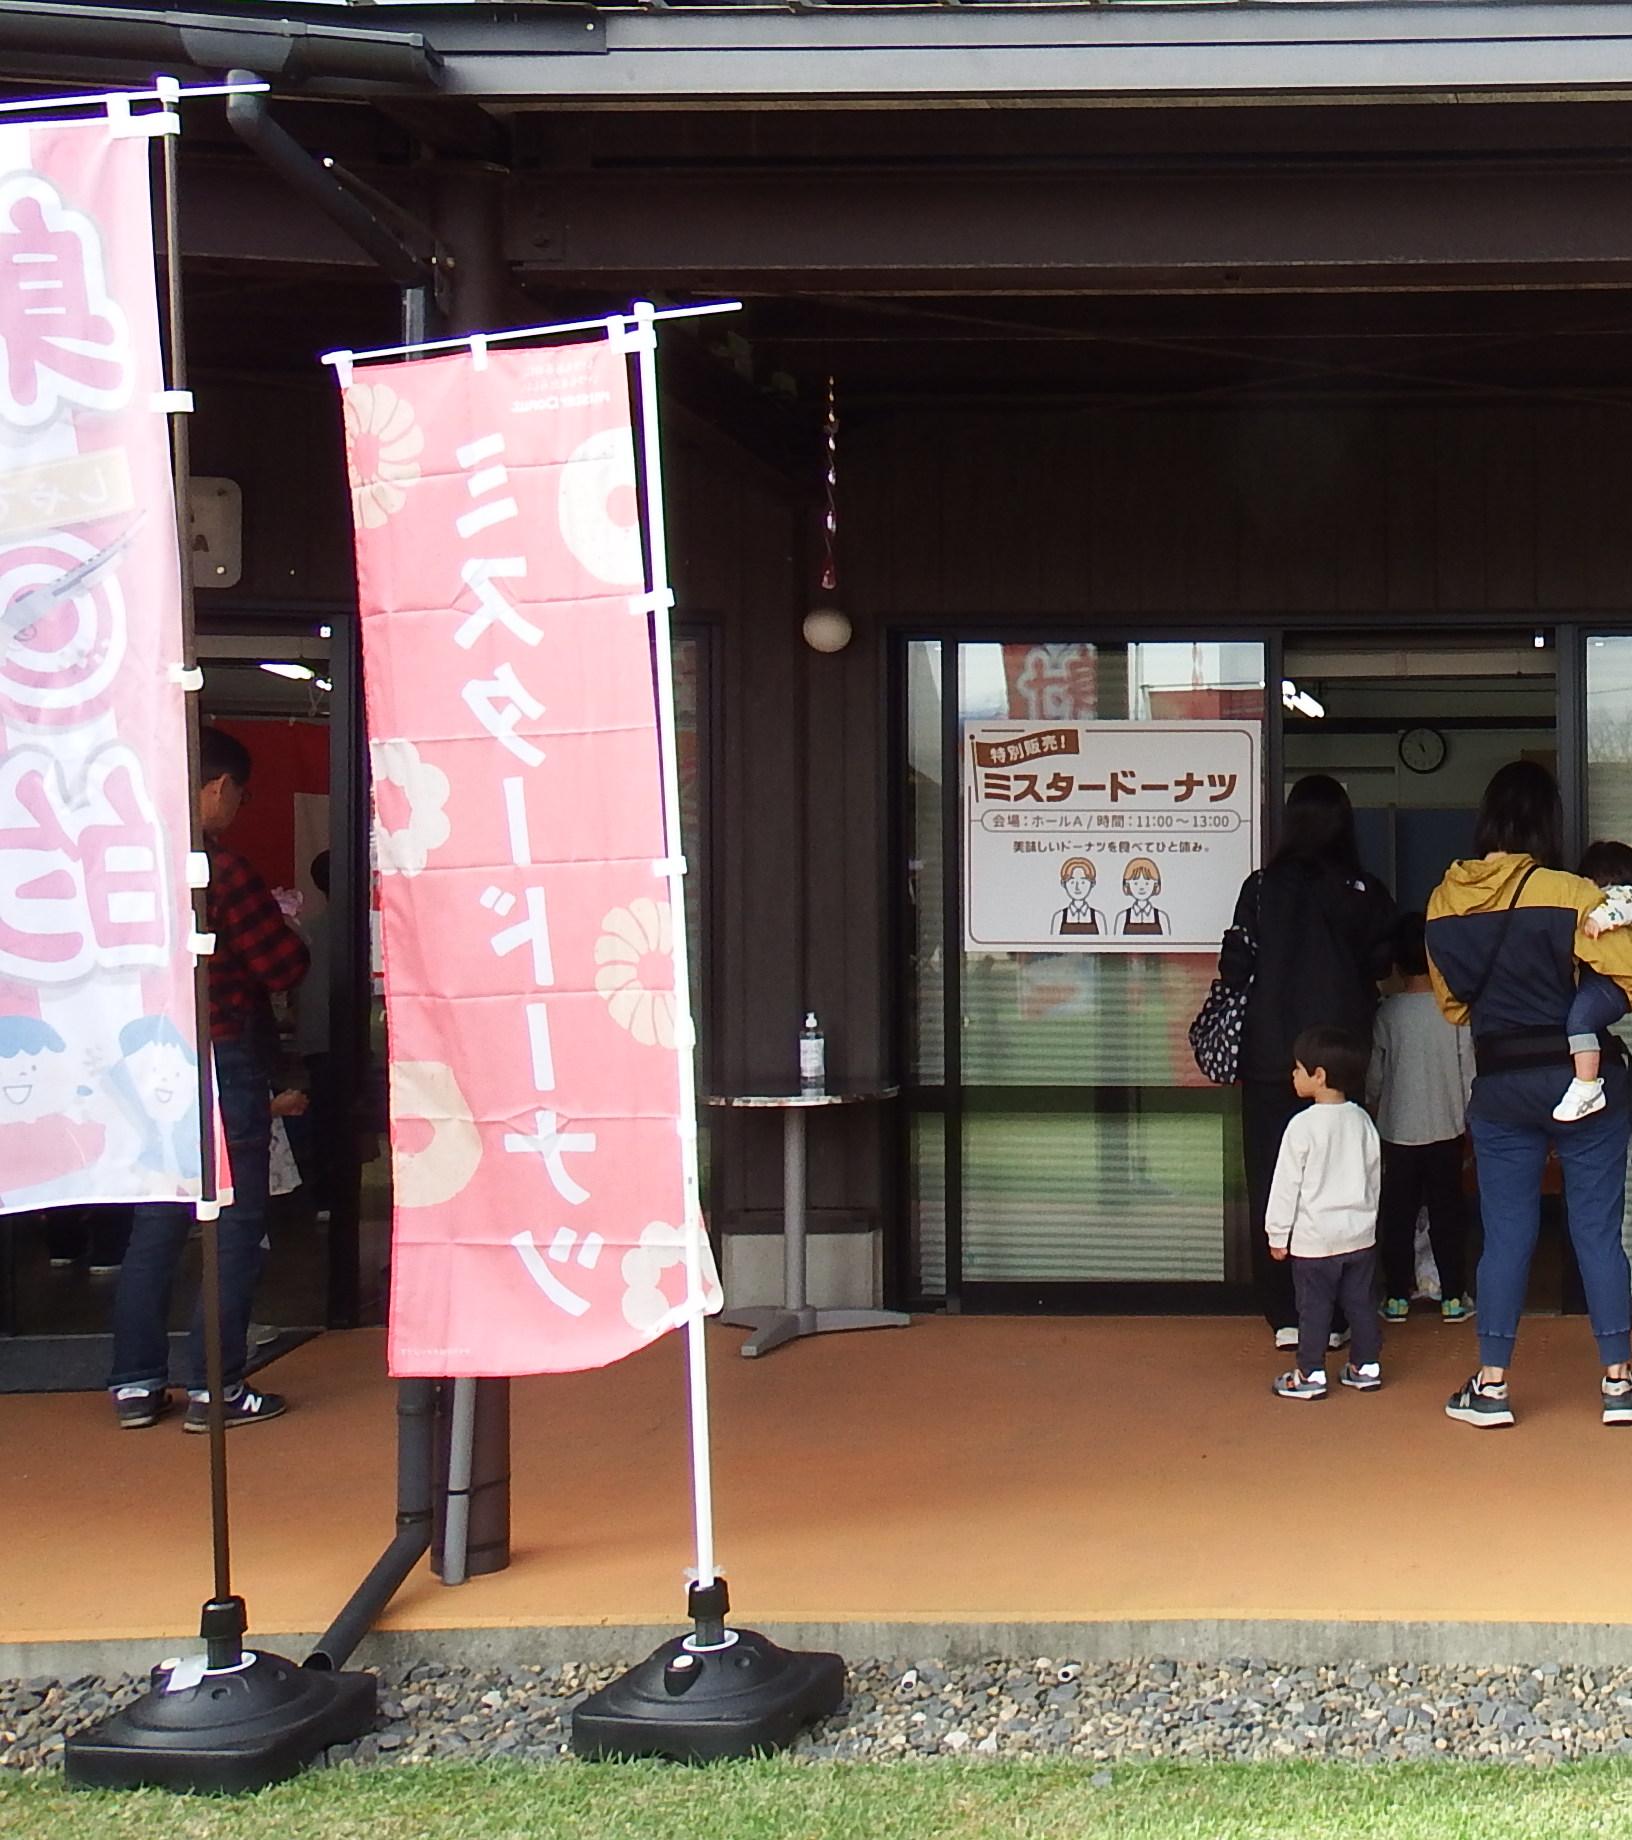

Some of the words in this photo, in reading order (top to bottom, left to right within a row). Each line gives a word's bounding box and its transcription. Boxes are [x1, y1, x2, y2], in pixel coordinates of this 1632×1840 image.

[989, 734, 1066, 764] 特別販売！
[984, 770, 1238, 803] ミスタードーナツ
[242, 1393, 262, 1413] N
